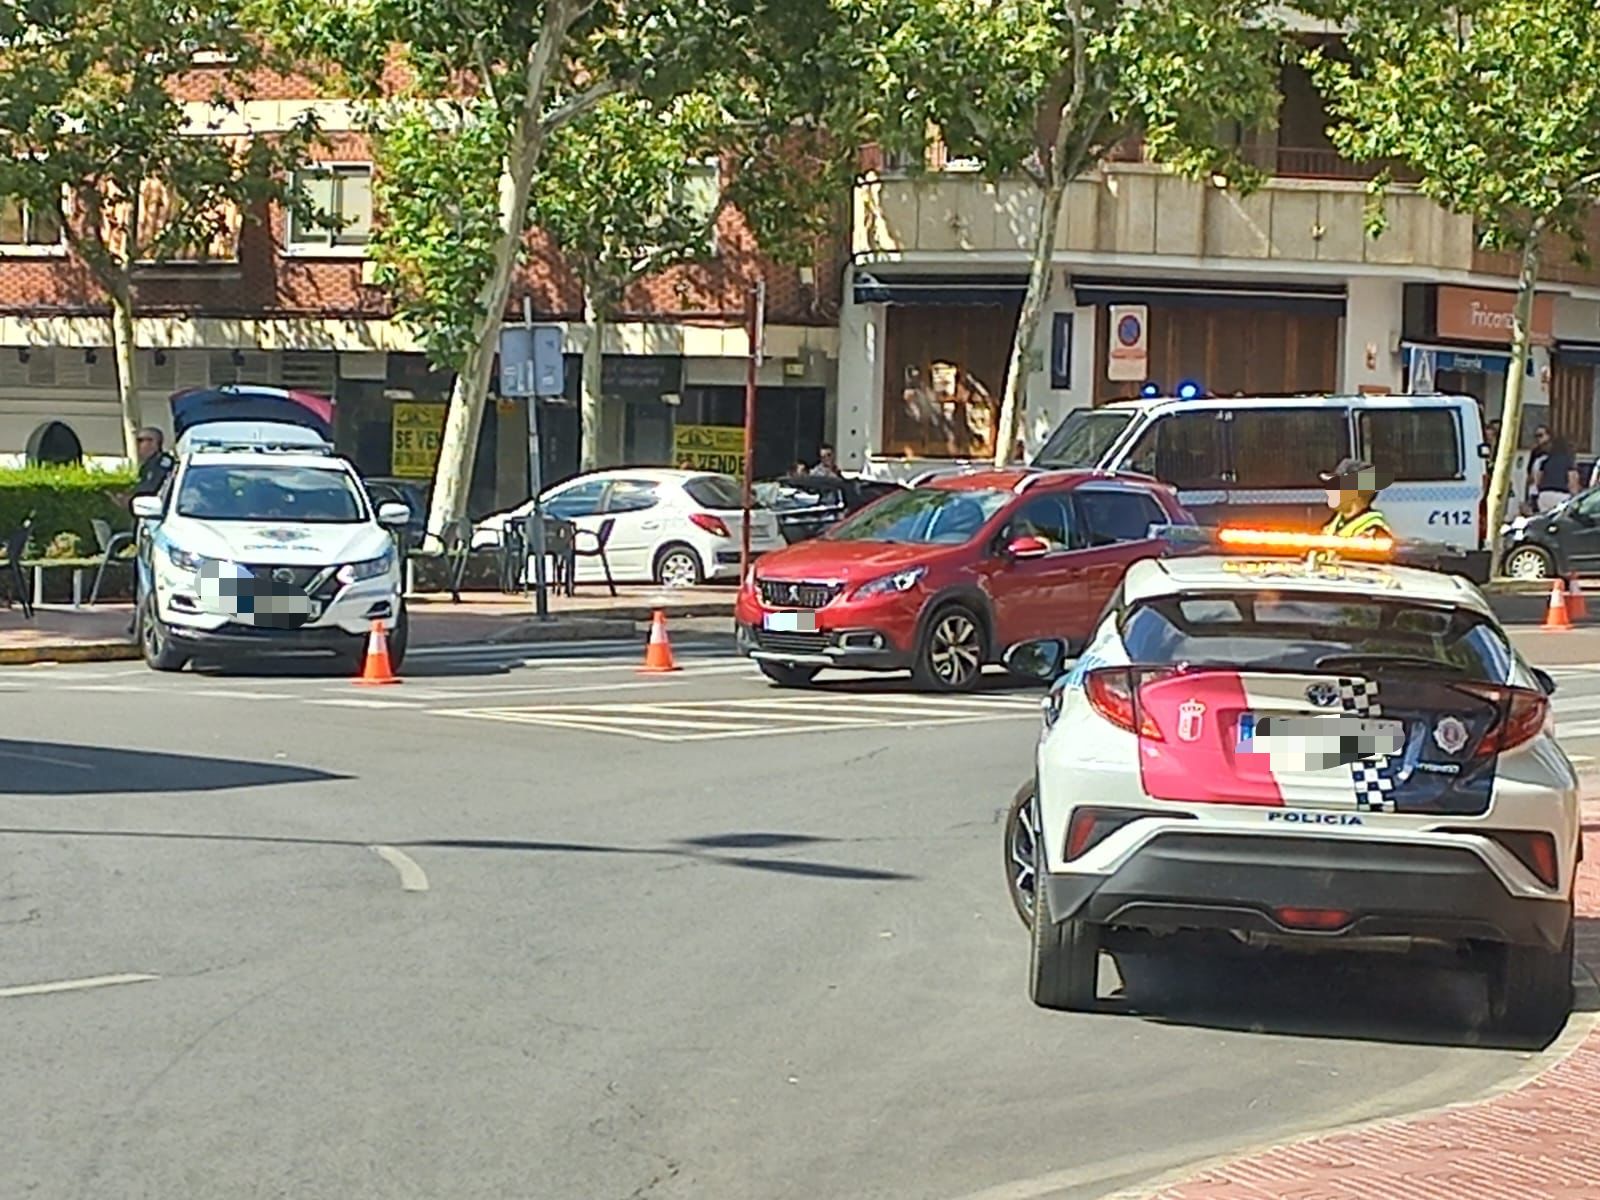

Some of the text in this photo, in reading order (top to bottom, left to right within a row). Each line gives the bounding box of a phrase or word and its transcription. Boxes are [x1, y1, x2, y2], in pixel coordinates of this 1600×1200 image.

[396, 430, 413, 449] SE
[1441, 510, 1472, 526] 112
[1268, 811, 1363, 825] POLICÍA
